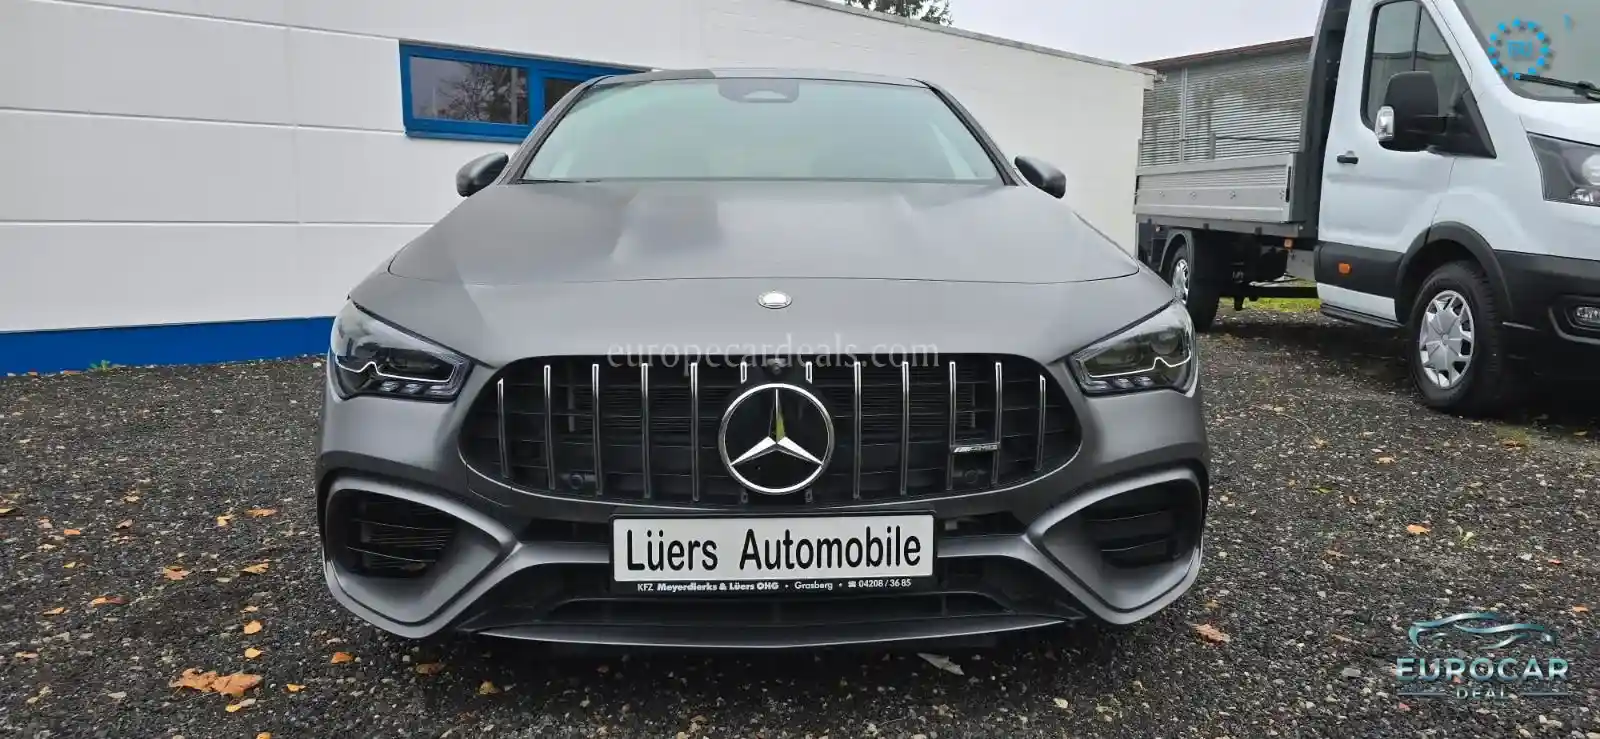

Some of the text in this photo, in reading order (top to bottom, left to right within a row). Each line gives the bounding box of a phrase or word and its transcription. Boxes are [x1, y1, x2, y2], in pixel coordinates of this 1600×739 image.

[626, 526, 921, 571] Lüers Automobile
[637, 583, 654, 591] KFZ
[657, 582, 717, 593] Meyerdierks
[729, 581, 755, 590] Lüers
[756, 581, 779, 590] OHG
[794, 580, 833, 591] Grasberg
